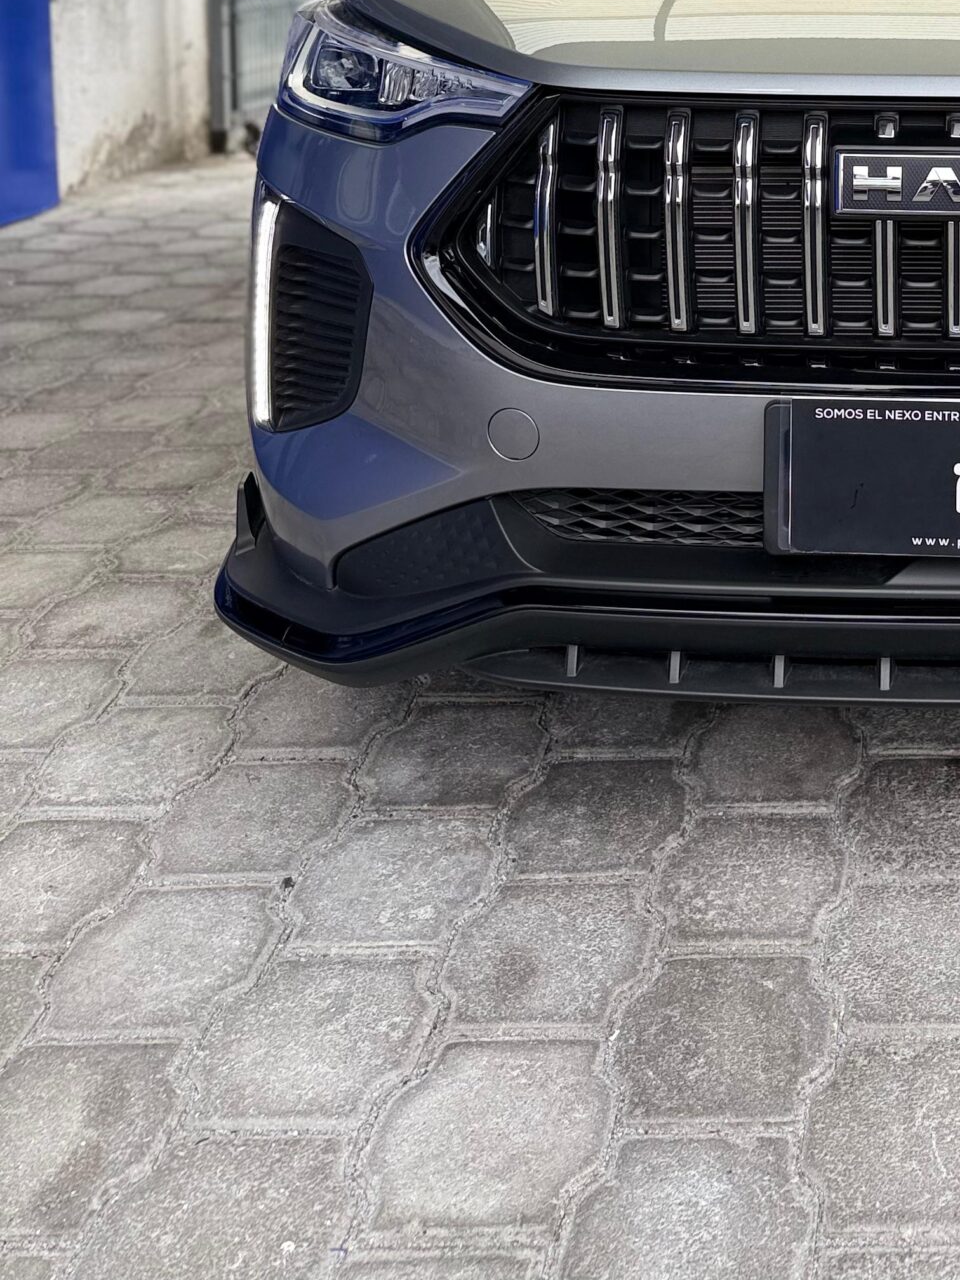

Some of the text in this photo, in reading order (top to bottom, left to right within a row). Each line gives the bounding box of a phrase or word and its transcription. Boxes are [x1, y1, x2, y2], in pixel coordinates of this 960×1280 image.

[815, 408, 863, 419] SOMOS
[867, 409, 882, 420] EL
[885, 410, 921, 420] NEXO
